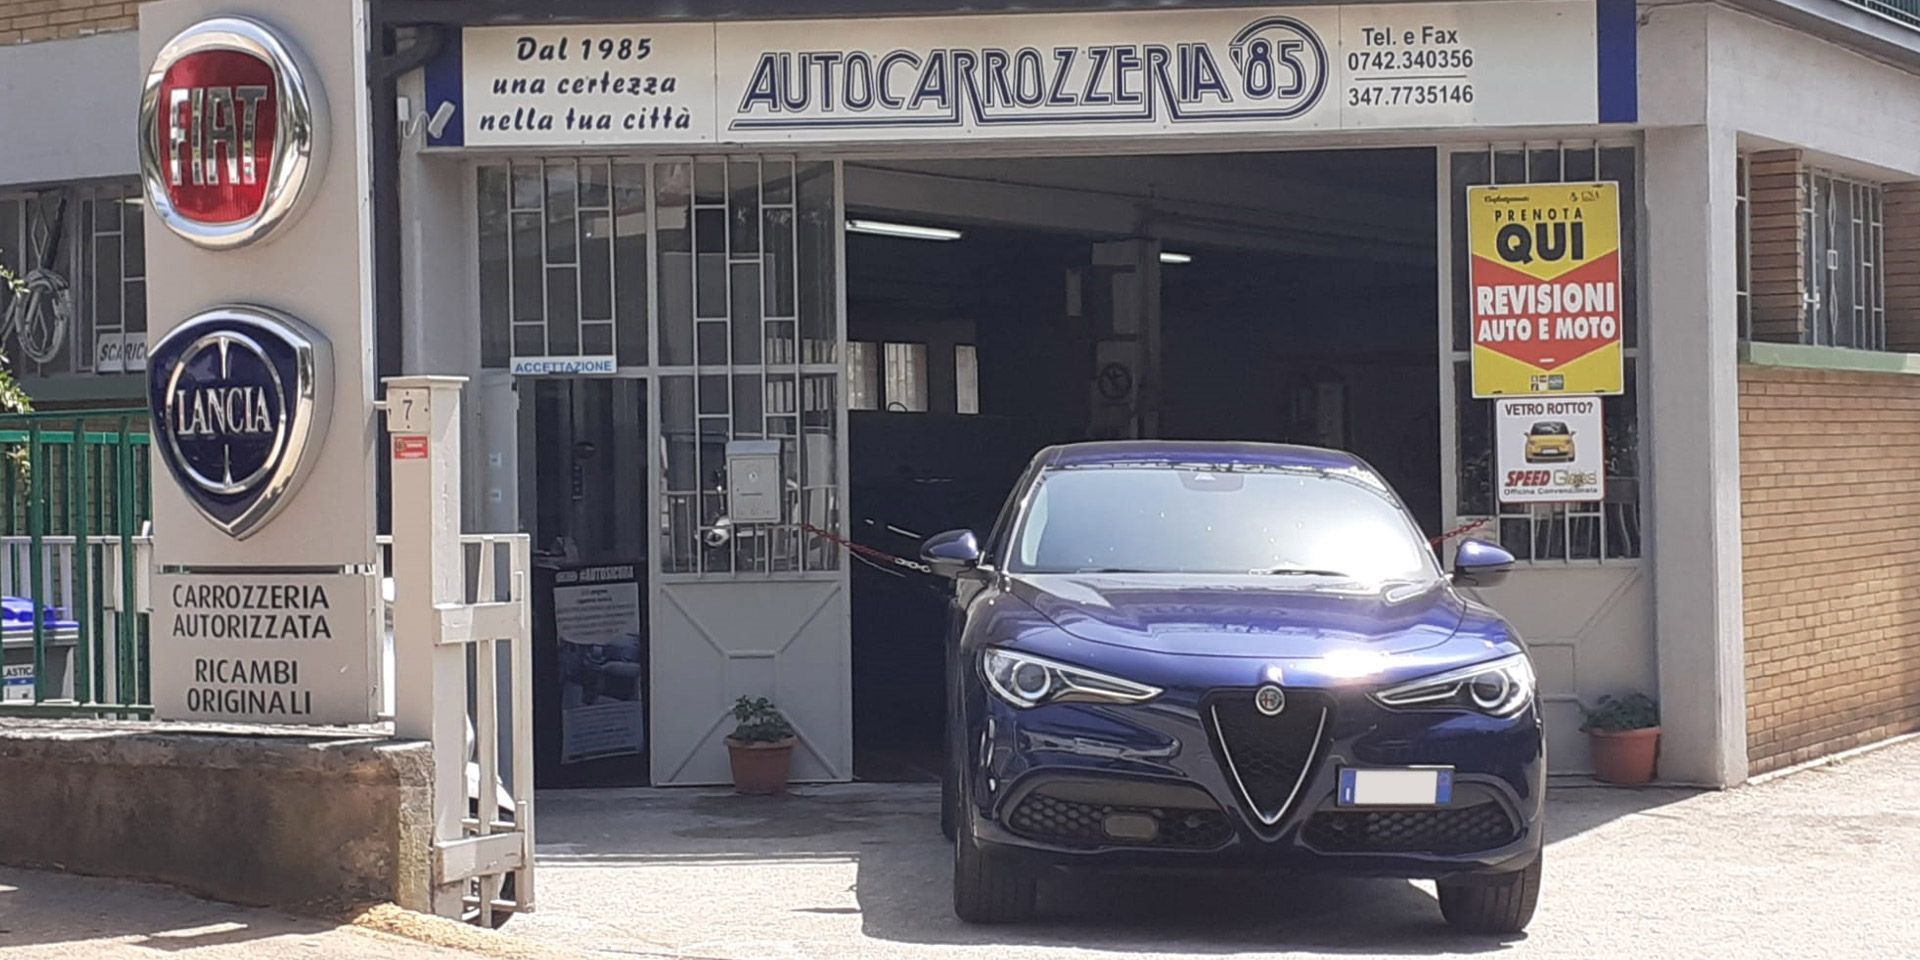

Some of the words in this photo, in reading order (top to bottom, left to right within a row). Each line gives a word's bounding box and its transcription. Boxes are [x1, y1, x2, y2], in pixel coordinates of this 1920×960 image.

[1361, 26, 1397, 46] Tel.
[1403, 30, 1415, 45] e
[1422, 25, 1458, 44] Fax
[516, 36, 568, 61] Dal
[581, 38, 652, 60] 1985
[1348, 49, 1473, 71] 0742.340356
[492, 76, 546, 95] una
[556, 71, 677, 96] certezza
[736, 43, 1234, 123] AUTOCARROZZERIA
[1348, 84, 1474, 106] 347.7735146
[479, 107, 553, 131] nella
[566, 107, 611, 130] tua
[623, 106, 690, 130] città
[168, 85, 268, 187] FIAT
[1494, 207, 1584, 222] PRENOTA
[1496, 221, 1585, 265] QUI
[1476, 281, 1616, 316] REVISIONI
[1477, 318, 1532, 342] AUTO
[1538, 317, 1550, 341] E
[1554, 315, 1617, 340] MOTO
[100, 342, 148, 361] SCARIC
[515, 360, 613, 373] ACCETTAZIONE
[176, 385, 273, 436] LANCIA
[402, 399, 413, 420] 7
[1504, 402, 1545, 416] VETRO
[1546, 401, 1594, 415] ROTTO?
[1504, 470, 1551, 487] SPEED
[172, 584, 330, 610] CARROZZERIA
[172, 614, 332, 640] AUTORIZZATA
[194, 658, 298, 685] RICAMBI
[186, 687, 312, 715] ORIGINALI
